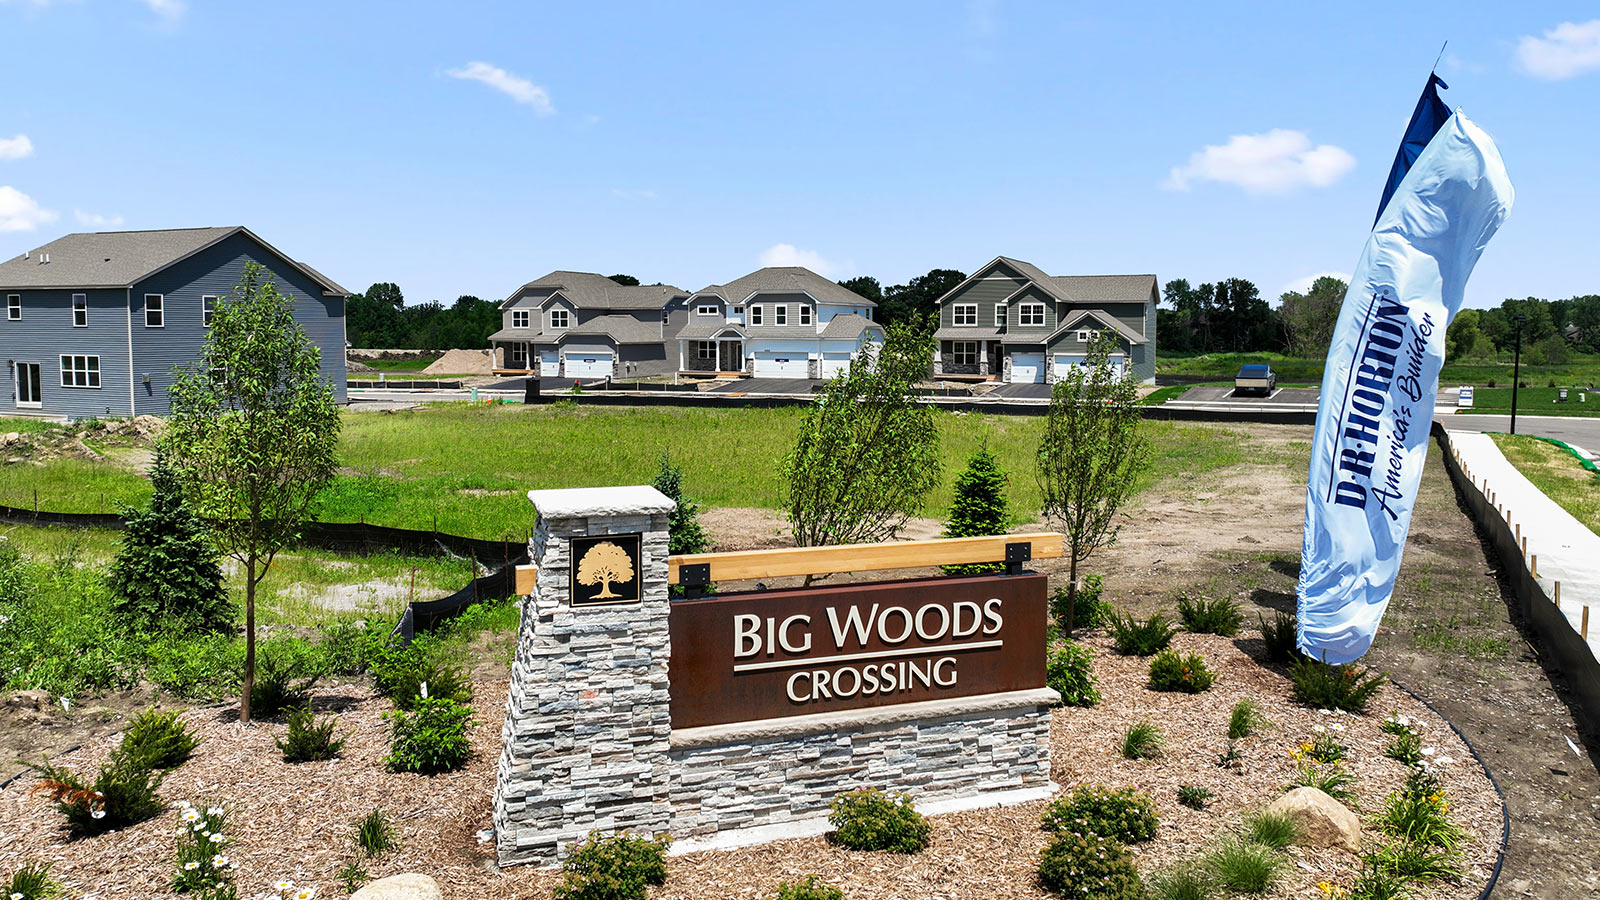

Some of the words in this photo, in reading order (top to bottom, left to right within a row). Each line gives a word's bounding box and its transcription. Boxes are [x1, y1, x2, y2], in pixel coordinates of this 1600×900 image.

[1371, 405, 1413, 521] America's
[1397, 312, 1435, 403] Builder
[734, 614, 812, 658] BIG
[826, 598, 1003, 648] WOODS
[786, 657, 958, 702] CROSSING
